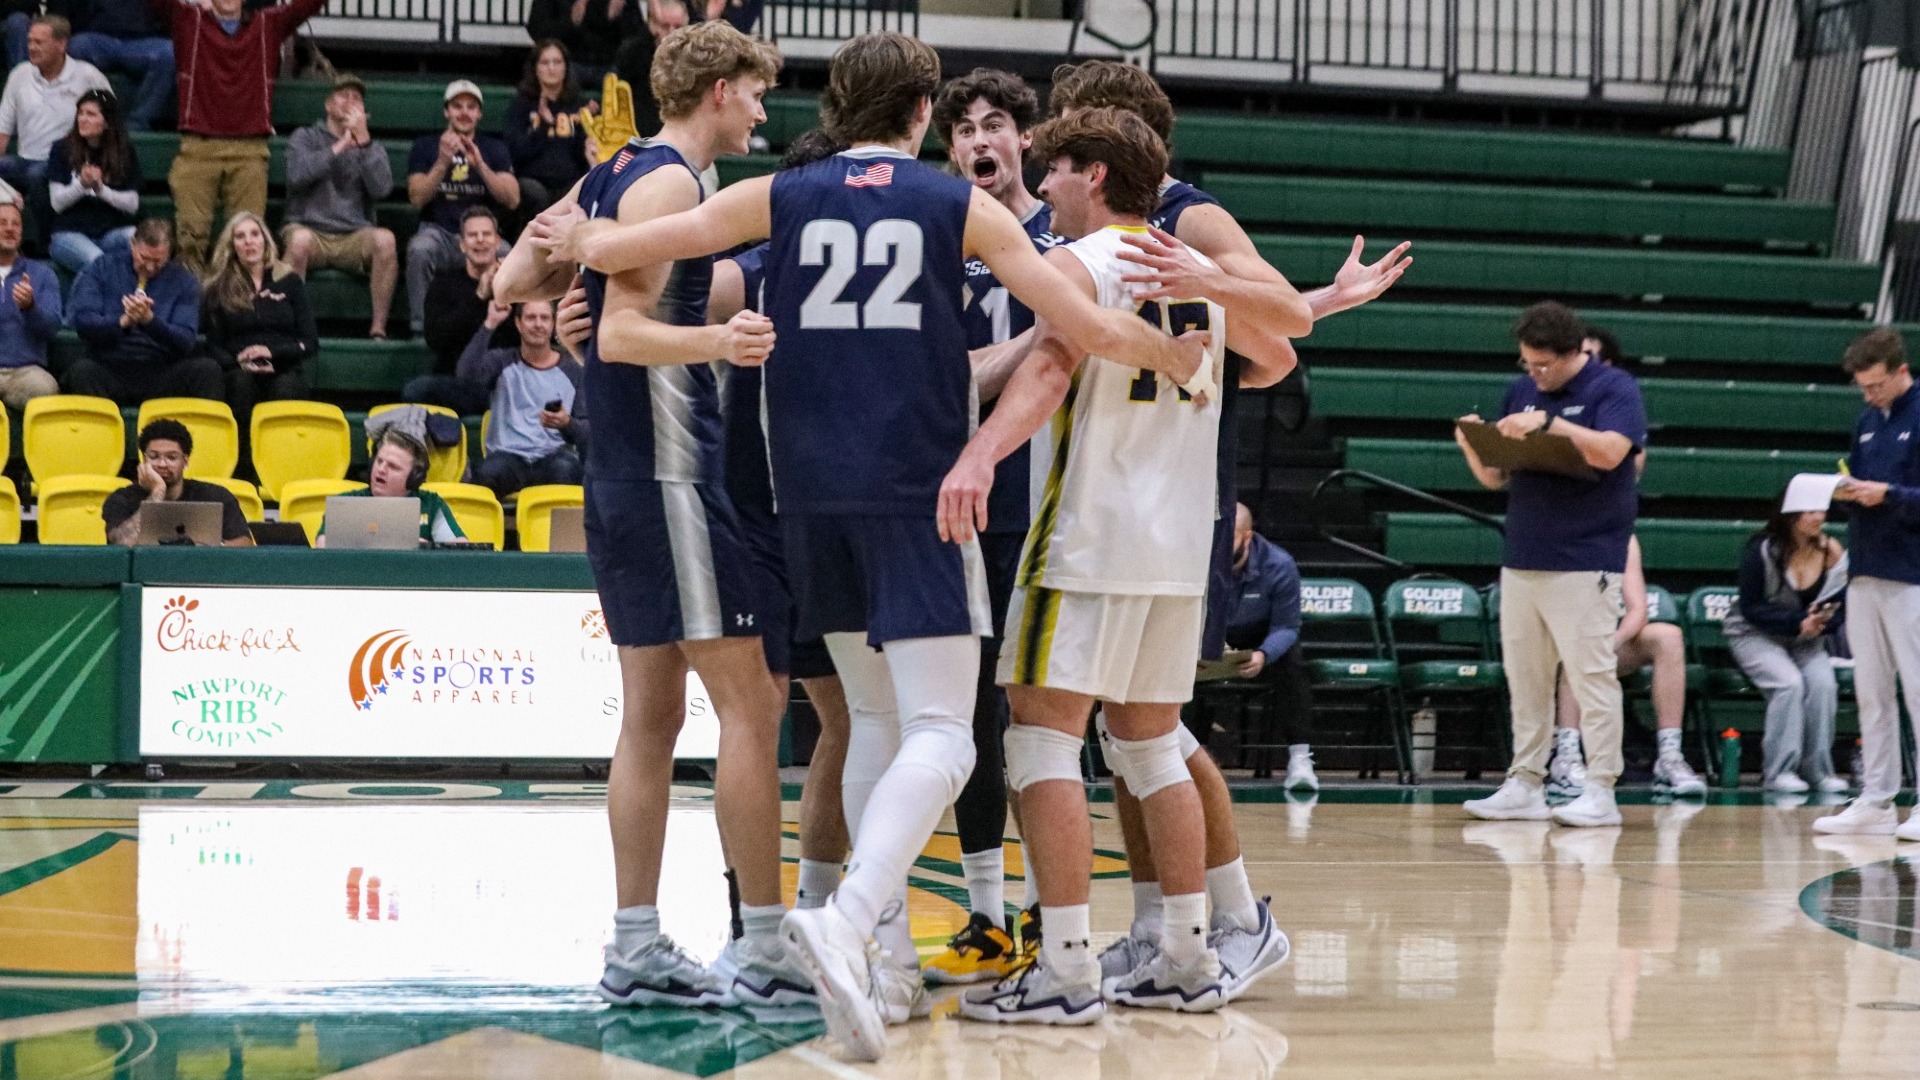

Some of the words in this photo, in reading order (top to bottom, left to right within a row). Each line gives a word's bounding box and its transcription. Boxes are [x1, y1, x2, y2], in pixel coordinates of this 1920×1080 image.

[799, 219, 924, 330] 22
[1402, 587, 1463, 600] GOLDEN
[1404, 600, 1462, 614] EAGLES
[157, 609, 302, 658] Chick-fil-A
[412, 648, 535, 662] NATIONAL
[412, 661, 535, 688] SPORTS
[171, 678, 288, 705] NEWPORT
[412, 689, 534, 704] APPAREL
[200, 700, 258, 723] RIB
[171, 720, 284, 748] COMPANY
